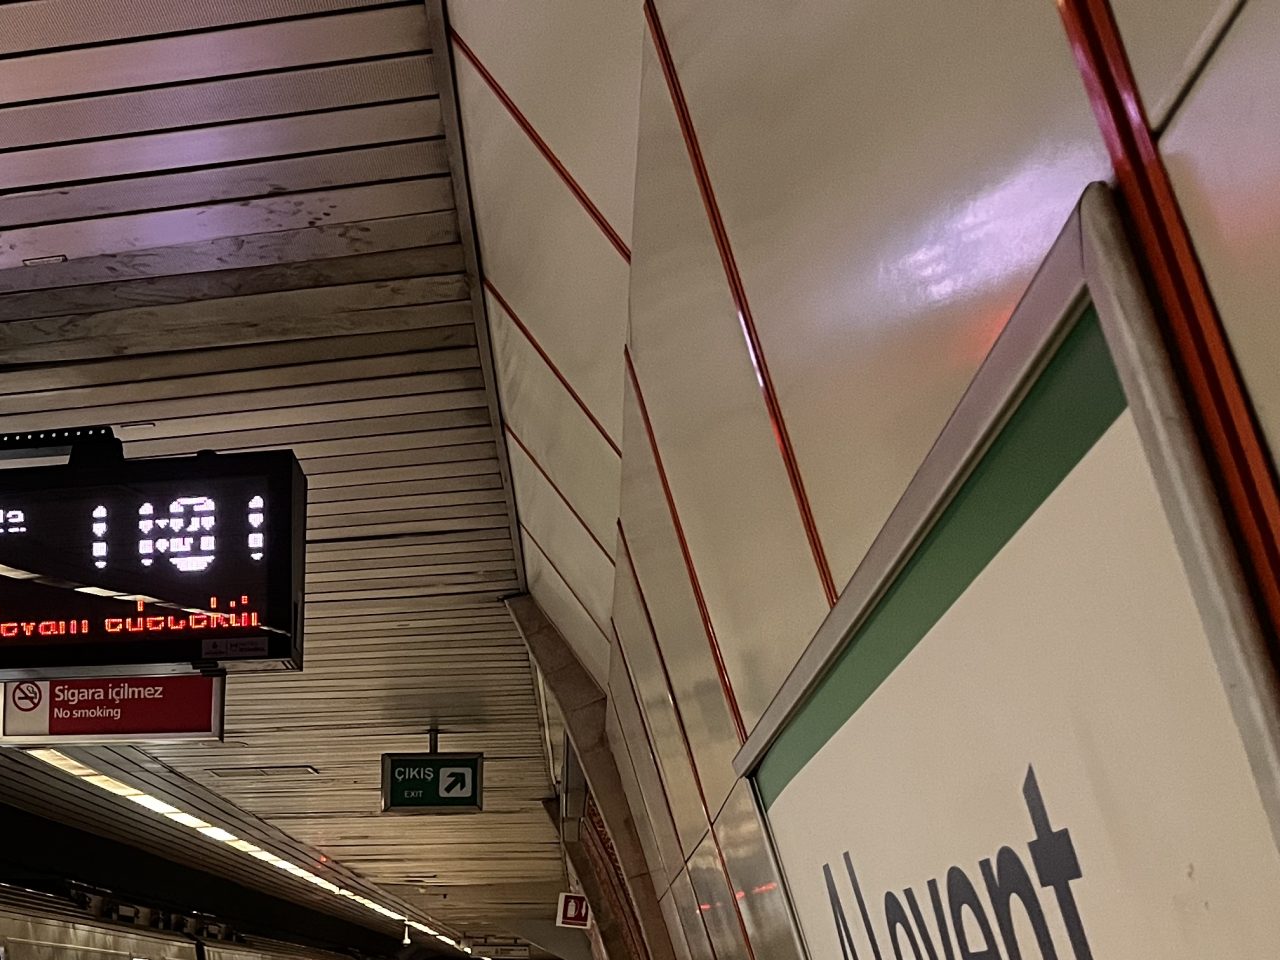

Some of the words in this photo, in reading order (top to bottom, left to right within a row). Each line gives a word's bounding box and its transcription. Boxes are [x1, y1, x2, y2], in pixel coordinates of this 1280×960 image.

[54, 685, 104, 705] Sigara
[108, 683, 164, 704] içilmez
[53, 707, 71, 719] No
[72, 705, 121, 720] smoking
[394, 767, 434, 782] ÇIKIŞ
[404, 790, 423, 798] EXIT
